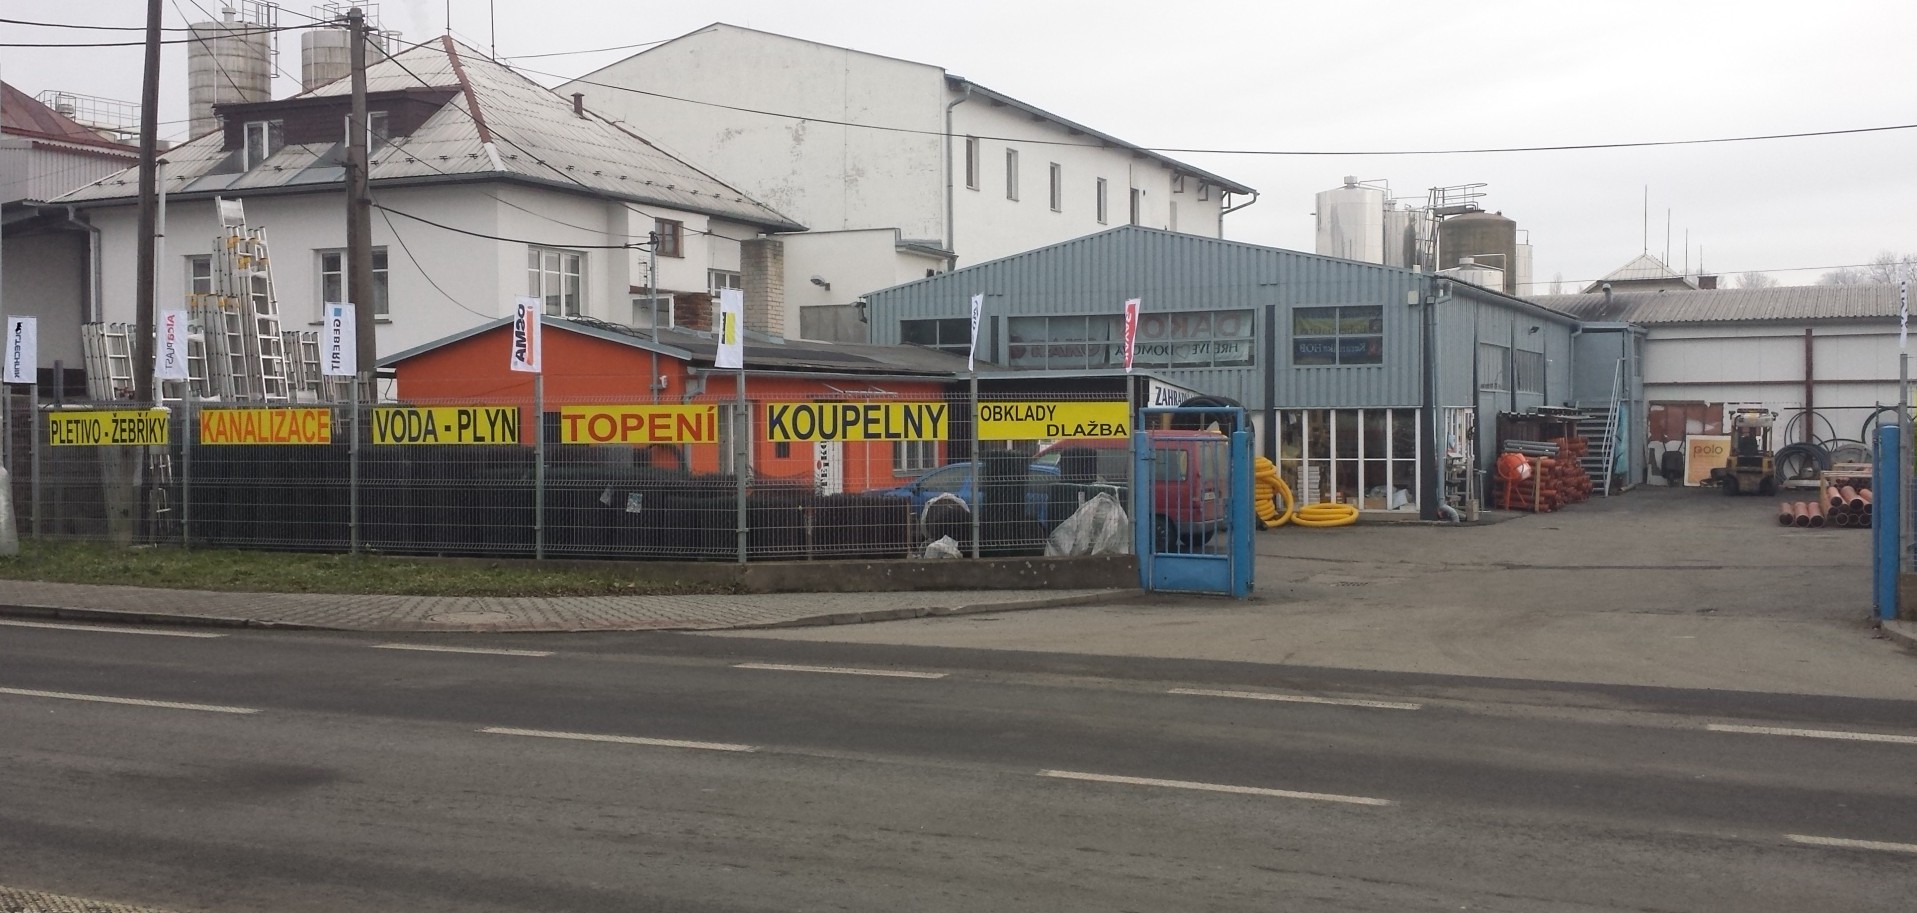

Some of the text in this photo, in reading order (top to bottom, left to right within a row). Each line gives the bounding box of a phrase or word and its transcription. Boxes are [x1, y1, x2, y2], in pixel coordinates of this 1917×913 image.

[51, 418, 101, 444] PLETIVO
[111, 412, 166, 444] ŽEBŘÍKY
[201, 410, 330, 443] KANALIZACE
[375, 409, 439, 443] VODA
[457, 408, 516, 443] PLYN
[562, 405, 715, 442] TOPENÍ
[768, 404, 946, 440] KOUPELNY
[980, 405, 1057, 421] OBKLADY
[1046, 420, 1128, 437] DLAŽBA
